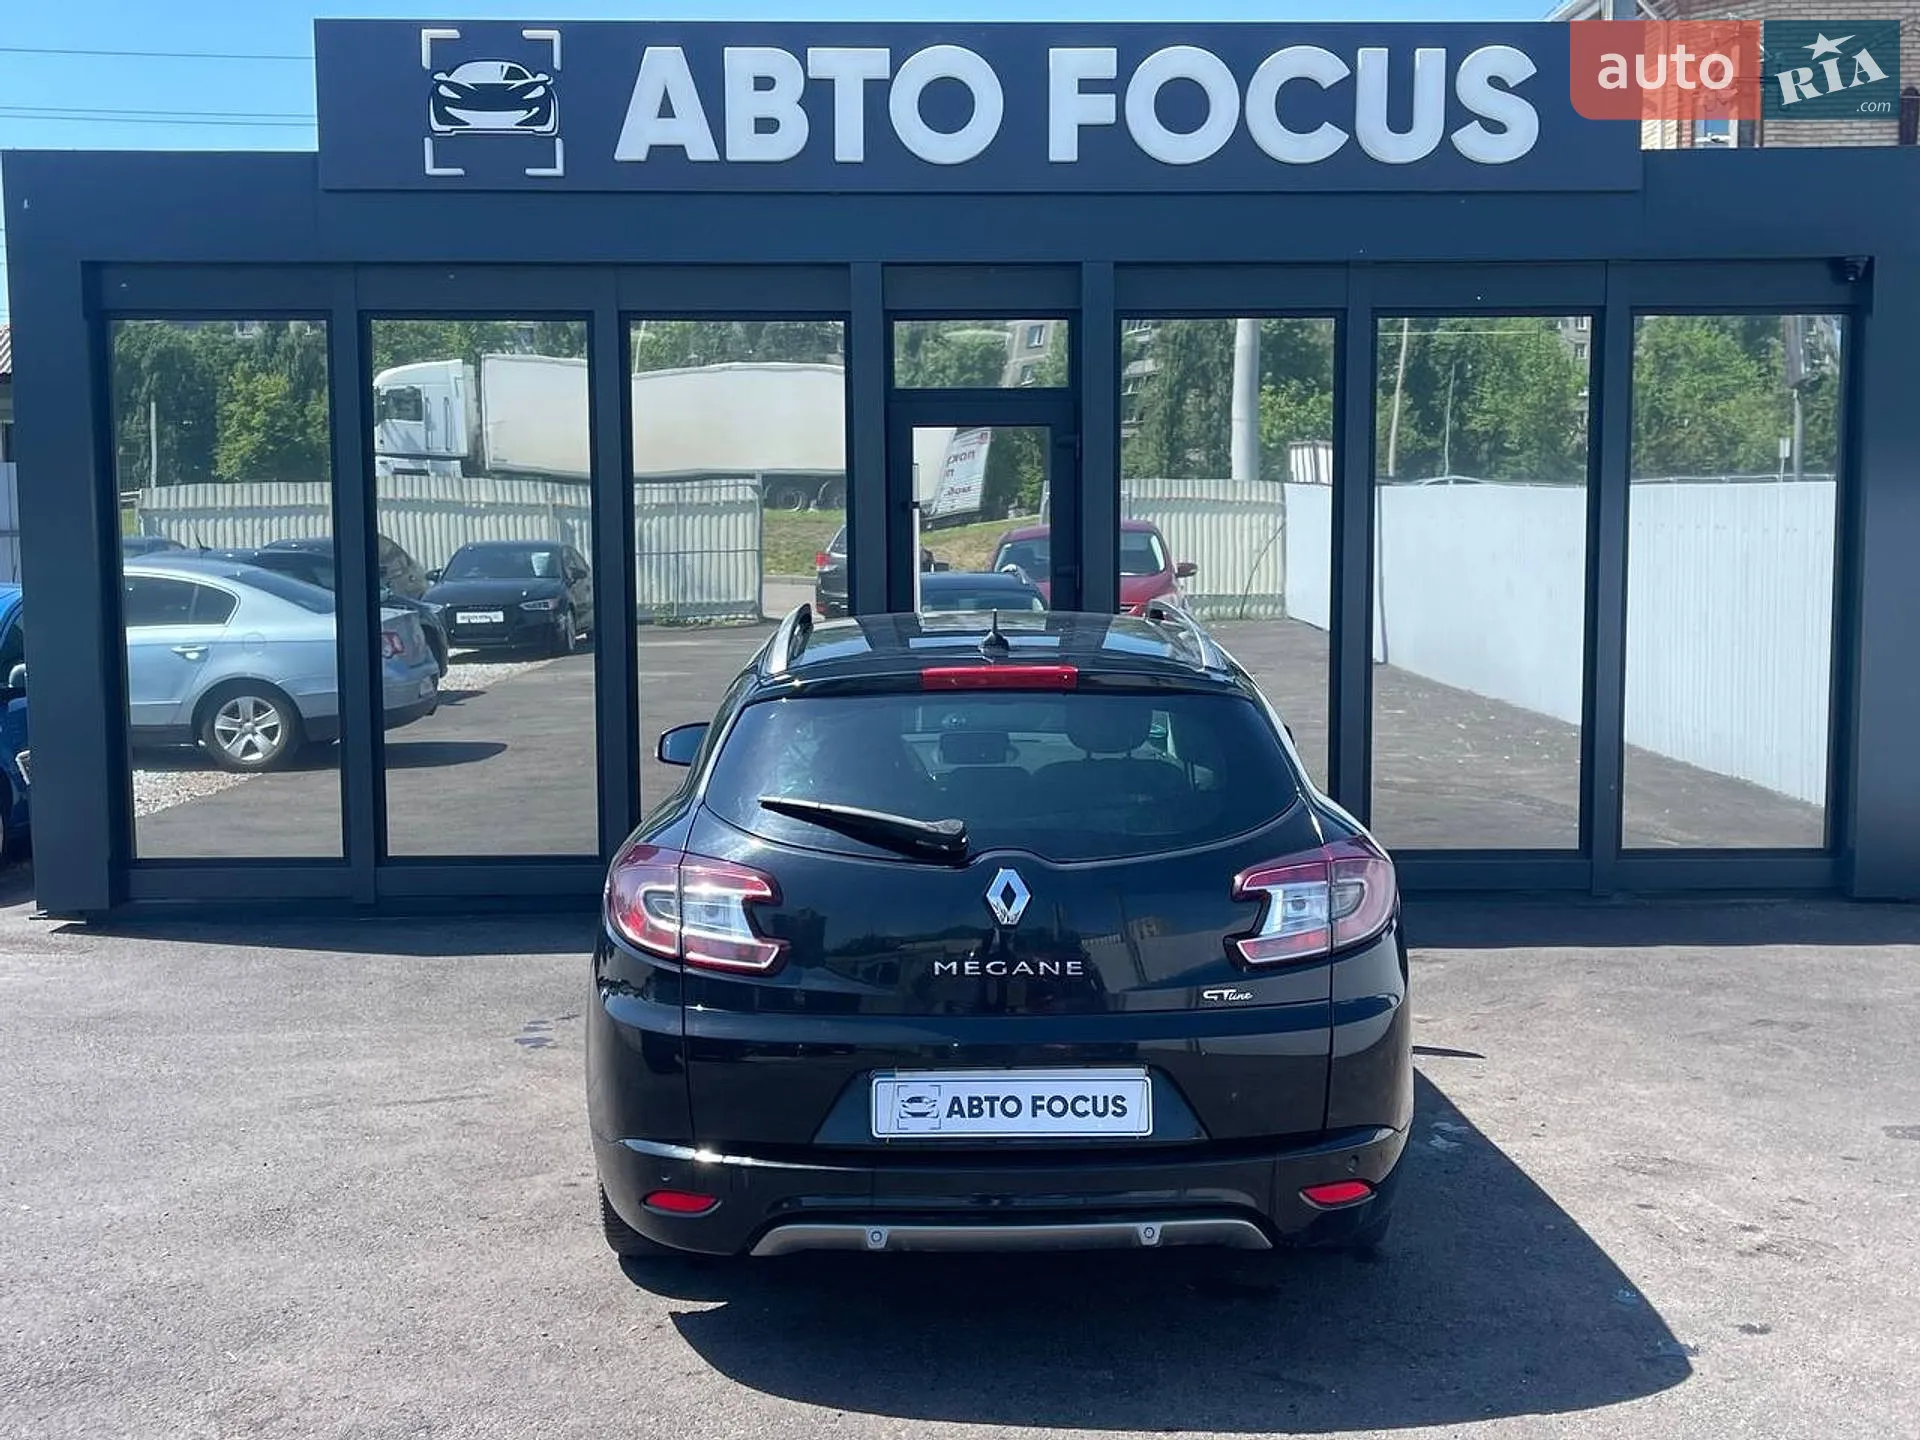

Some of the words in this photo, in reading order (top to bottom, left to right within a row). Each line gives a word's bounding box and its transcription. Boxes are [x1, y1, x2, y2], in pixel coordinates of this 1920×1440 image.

[615, 45, 1003, 164] АВТО
[1049, 45, 1538, 163] FOCUS
[946, 1095, 1023, 1118] АВТО
[1031, 1095, 1128, 1118] FOCUS
